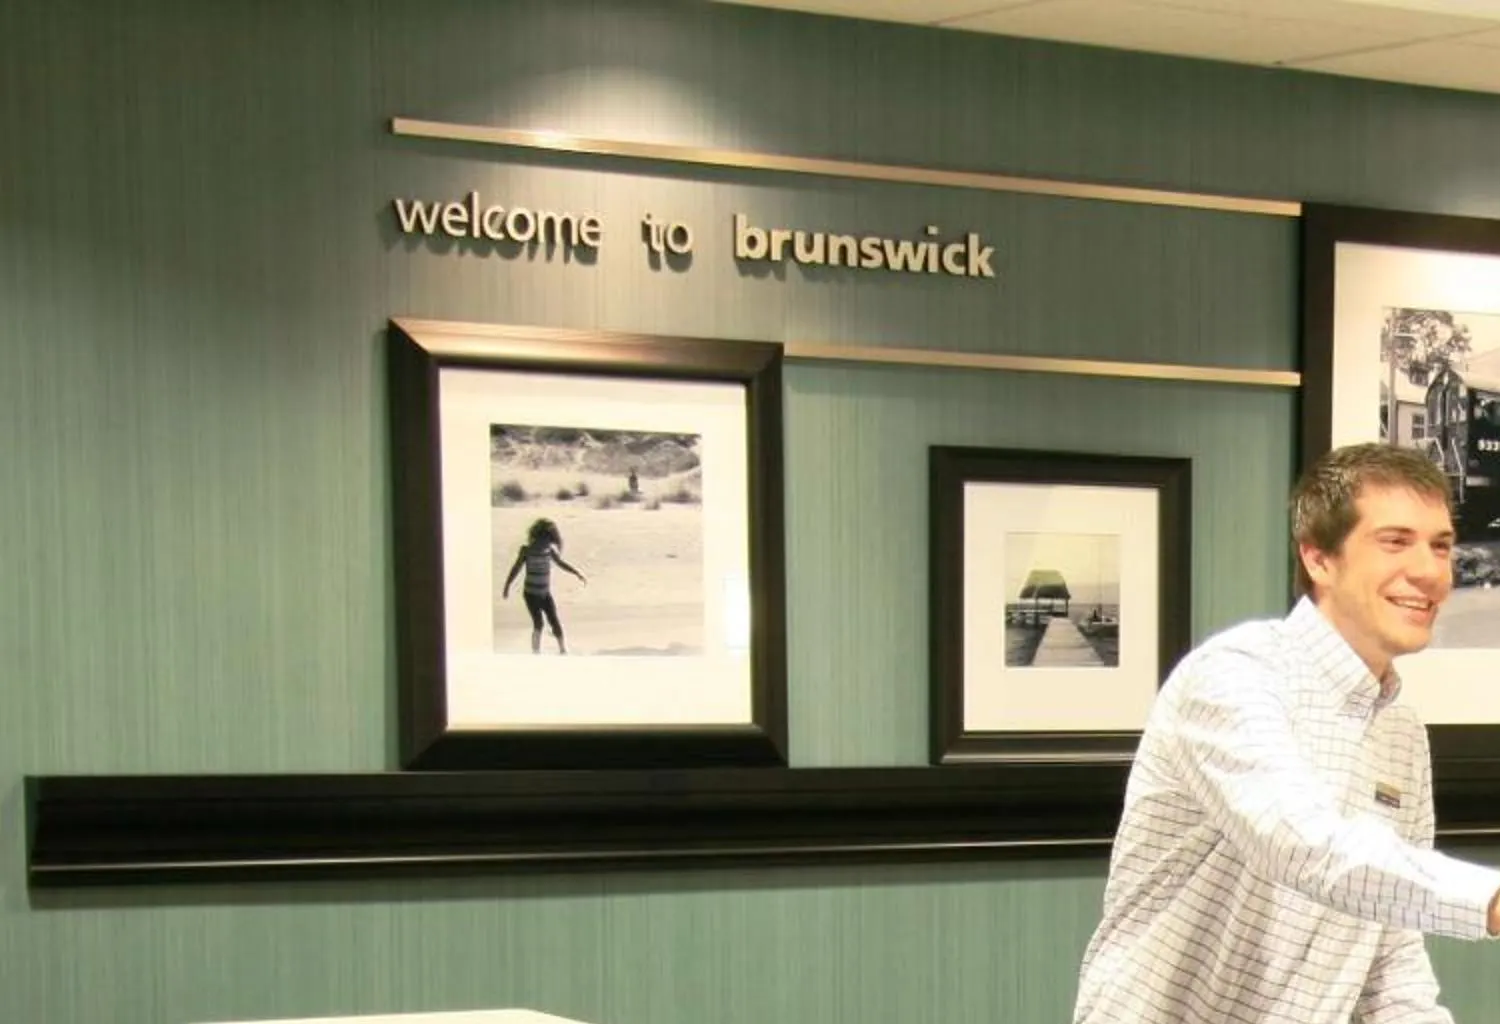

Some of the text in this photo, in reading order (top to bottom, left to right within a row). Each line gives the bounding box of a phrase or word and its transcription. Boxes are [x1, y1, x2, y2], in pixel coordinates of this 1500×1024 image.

[395, 191, 996, 278] welcome to brunswick
